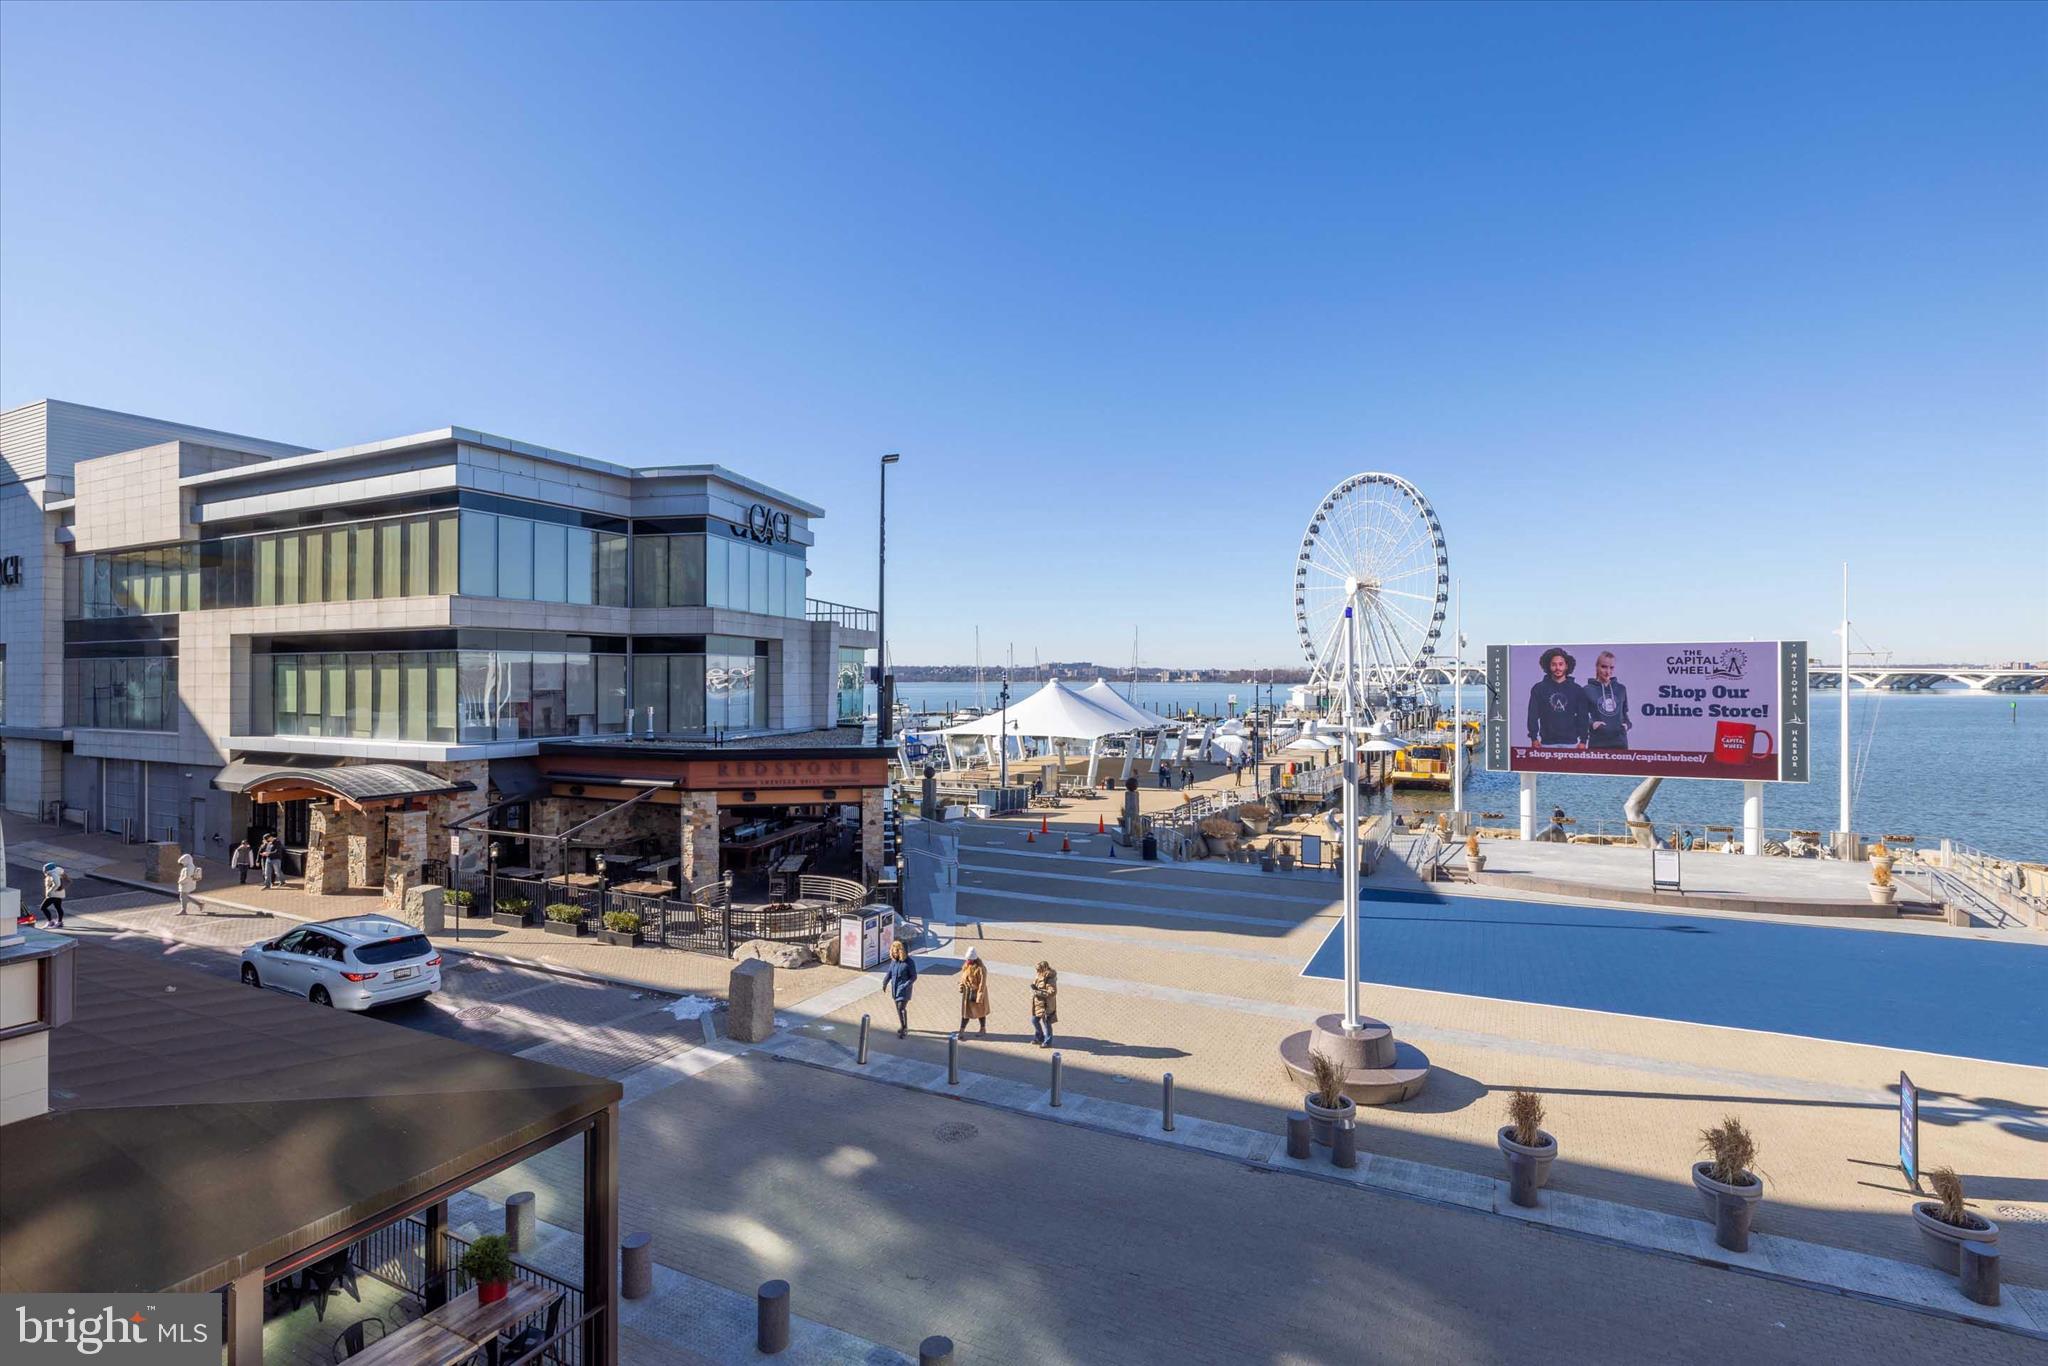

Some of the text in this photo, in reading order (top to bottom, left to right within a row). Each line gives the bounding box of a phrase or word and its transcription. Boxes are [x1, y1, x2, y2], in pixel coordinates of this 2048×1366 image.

[1666, 656, 1719, 665] CAPITAL
[1667, 666, 1712, 675] WHEEL
[1658, 685, 1750, 701] Shop Our
[1641, 703, 1769, 718] Online Store!
[1721, 736, 1746, 744] CAPITAL
[1529, 750, 1707, 763] shop.spreadshirt.com/capitalwheel/
[718, 761, 861, 776] REDSTONE
